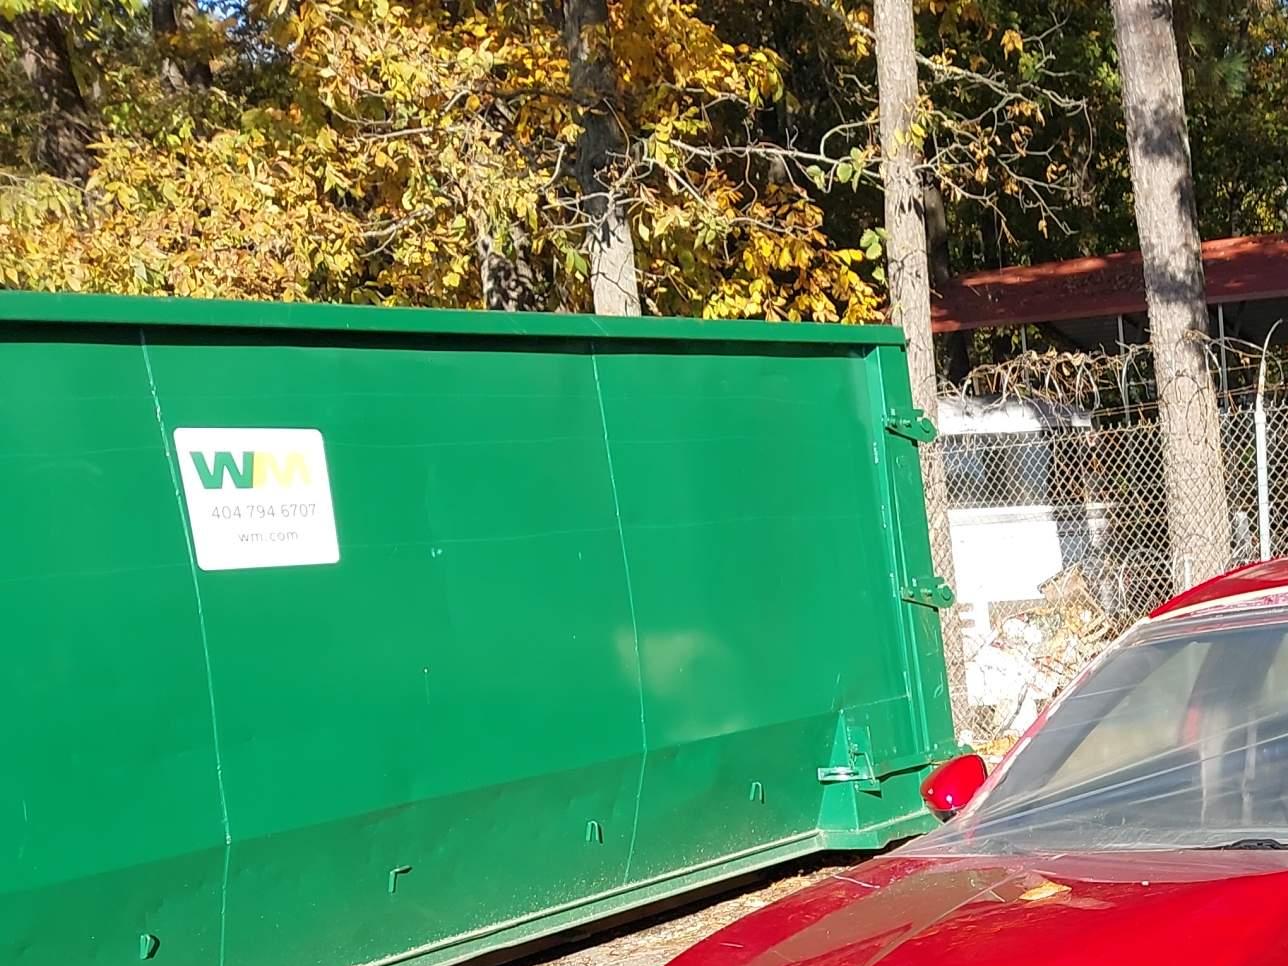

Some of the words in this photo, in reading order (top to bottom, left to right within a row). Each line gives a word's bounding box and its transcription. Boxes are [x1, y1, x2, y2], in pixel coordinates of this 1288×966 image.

[189, 450, 311, 490] WM
[211, 505, 242, 520] 404
[246, 504, 275, 519] 794
[280, 503, 316, 518] 6707
